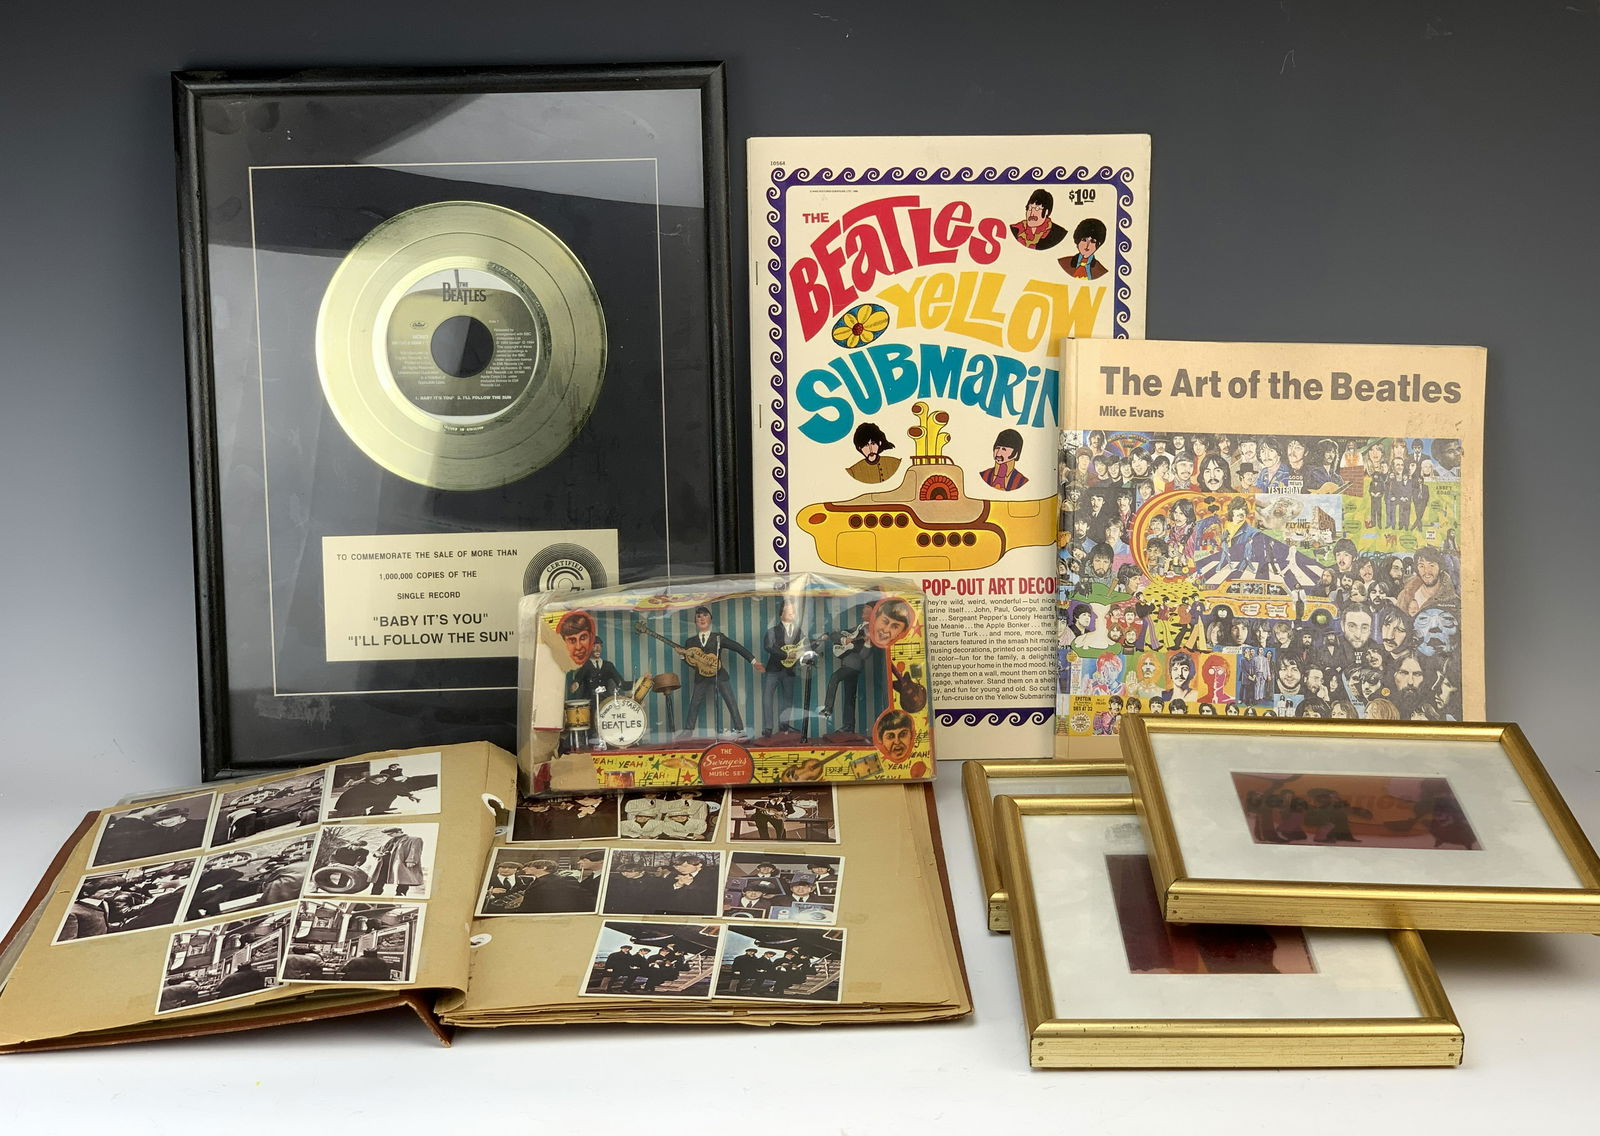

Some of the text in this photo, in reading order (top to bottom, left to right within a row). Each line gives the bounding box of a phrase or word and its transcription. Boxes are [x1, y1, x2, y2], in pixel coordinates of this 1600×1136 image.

[802, 212, 829, 224] THE
[442, 282, 486, 305] BEATLES
[1100, 366, 1462, 404] The Art of the Beatles
[1099, 406, 1164, 418] Mike Evans
[351, 552, 412, 560] COMMEMORATE
[547, 561, 583, 572] CERTIFIED
[379, 573, 413, 581] 1,000,000
[922, 578, 984, 596] POP-OUT
[989, 578, 1015, 595] ART
[429, 591, 460, 599] RECORD
[373, 613, 488, 628] "BABY IT'S YOU"
[348, 630, 514, 646] "I'LL FOLLOW THE SUN"
[622, 700, 640, 713] STARR
[602, 720, 642, 733] BEATLES
[703, 754, 747, 769] Swingers
[888, 760, 911, 770] YEAH!
